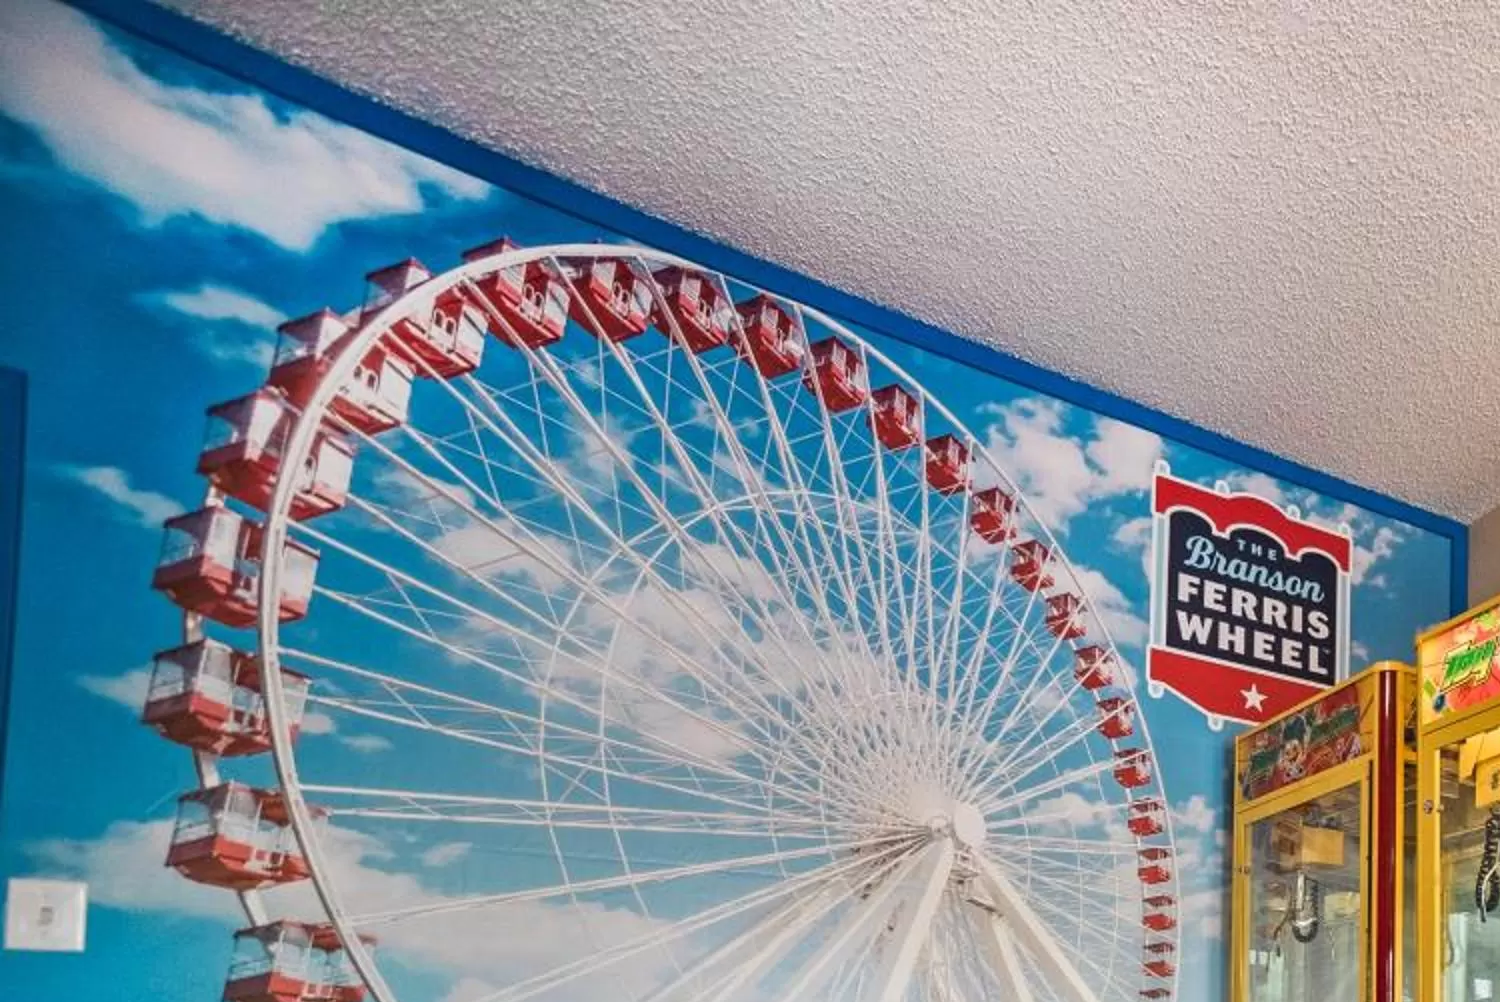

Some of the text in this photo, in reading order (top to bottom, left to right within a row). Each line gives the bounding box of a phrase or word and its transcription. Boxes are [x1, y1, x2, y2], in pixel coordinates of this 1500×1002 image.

[1183, 534, 1326, 603] Branson
[1237, 538, 1278, 561] THE
[1176, 571, 1330, 640] FERRIS
[1175, 609, 1329, 676] WHEEL
